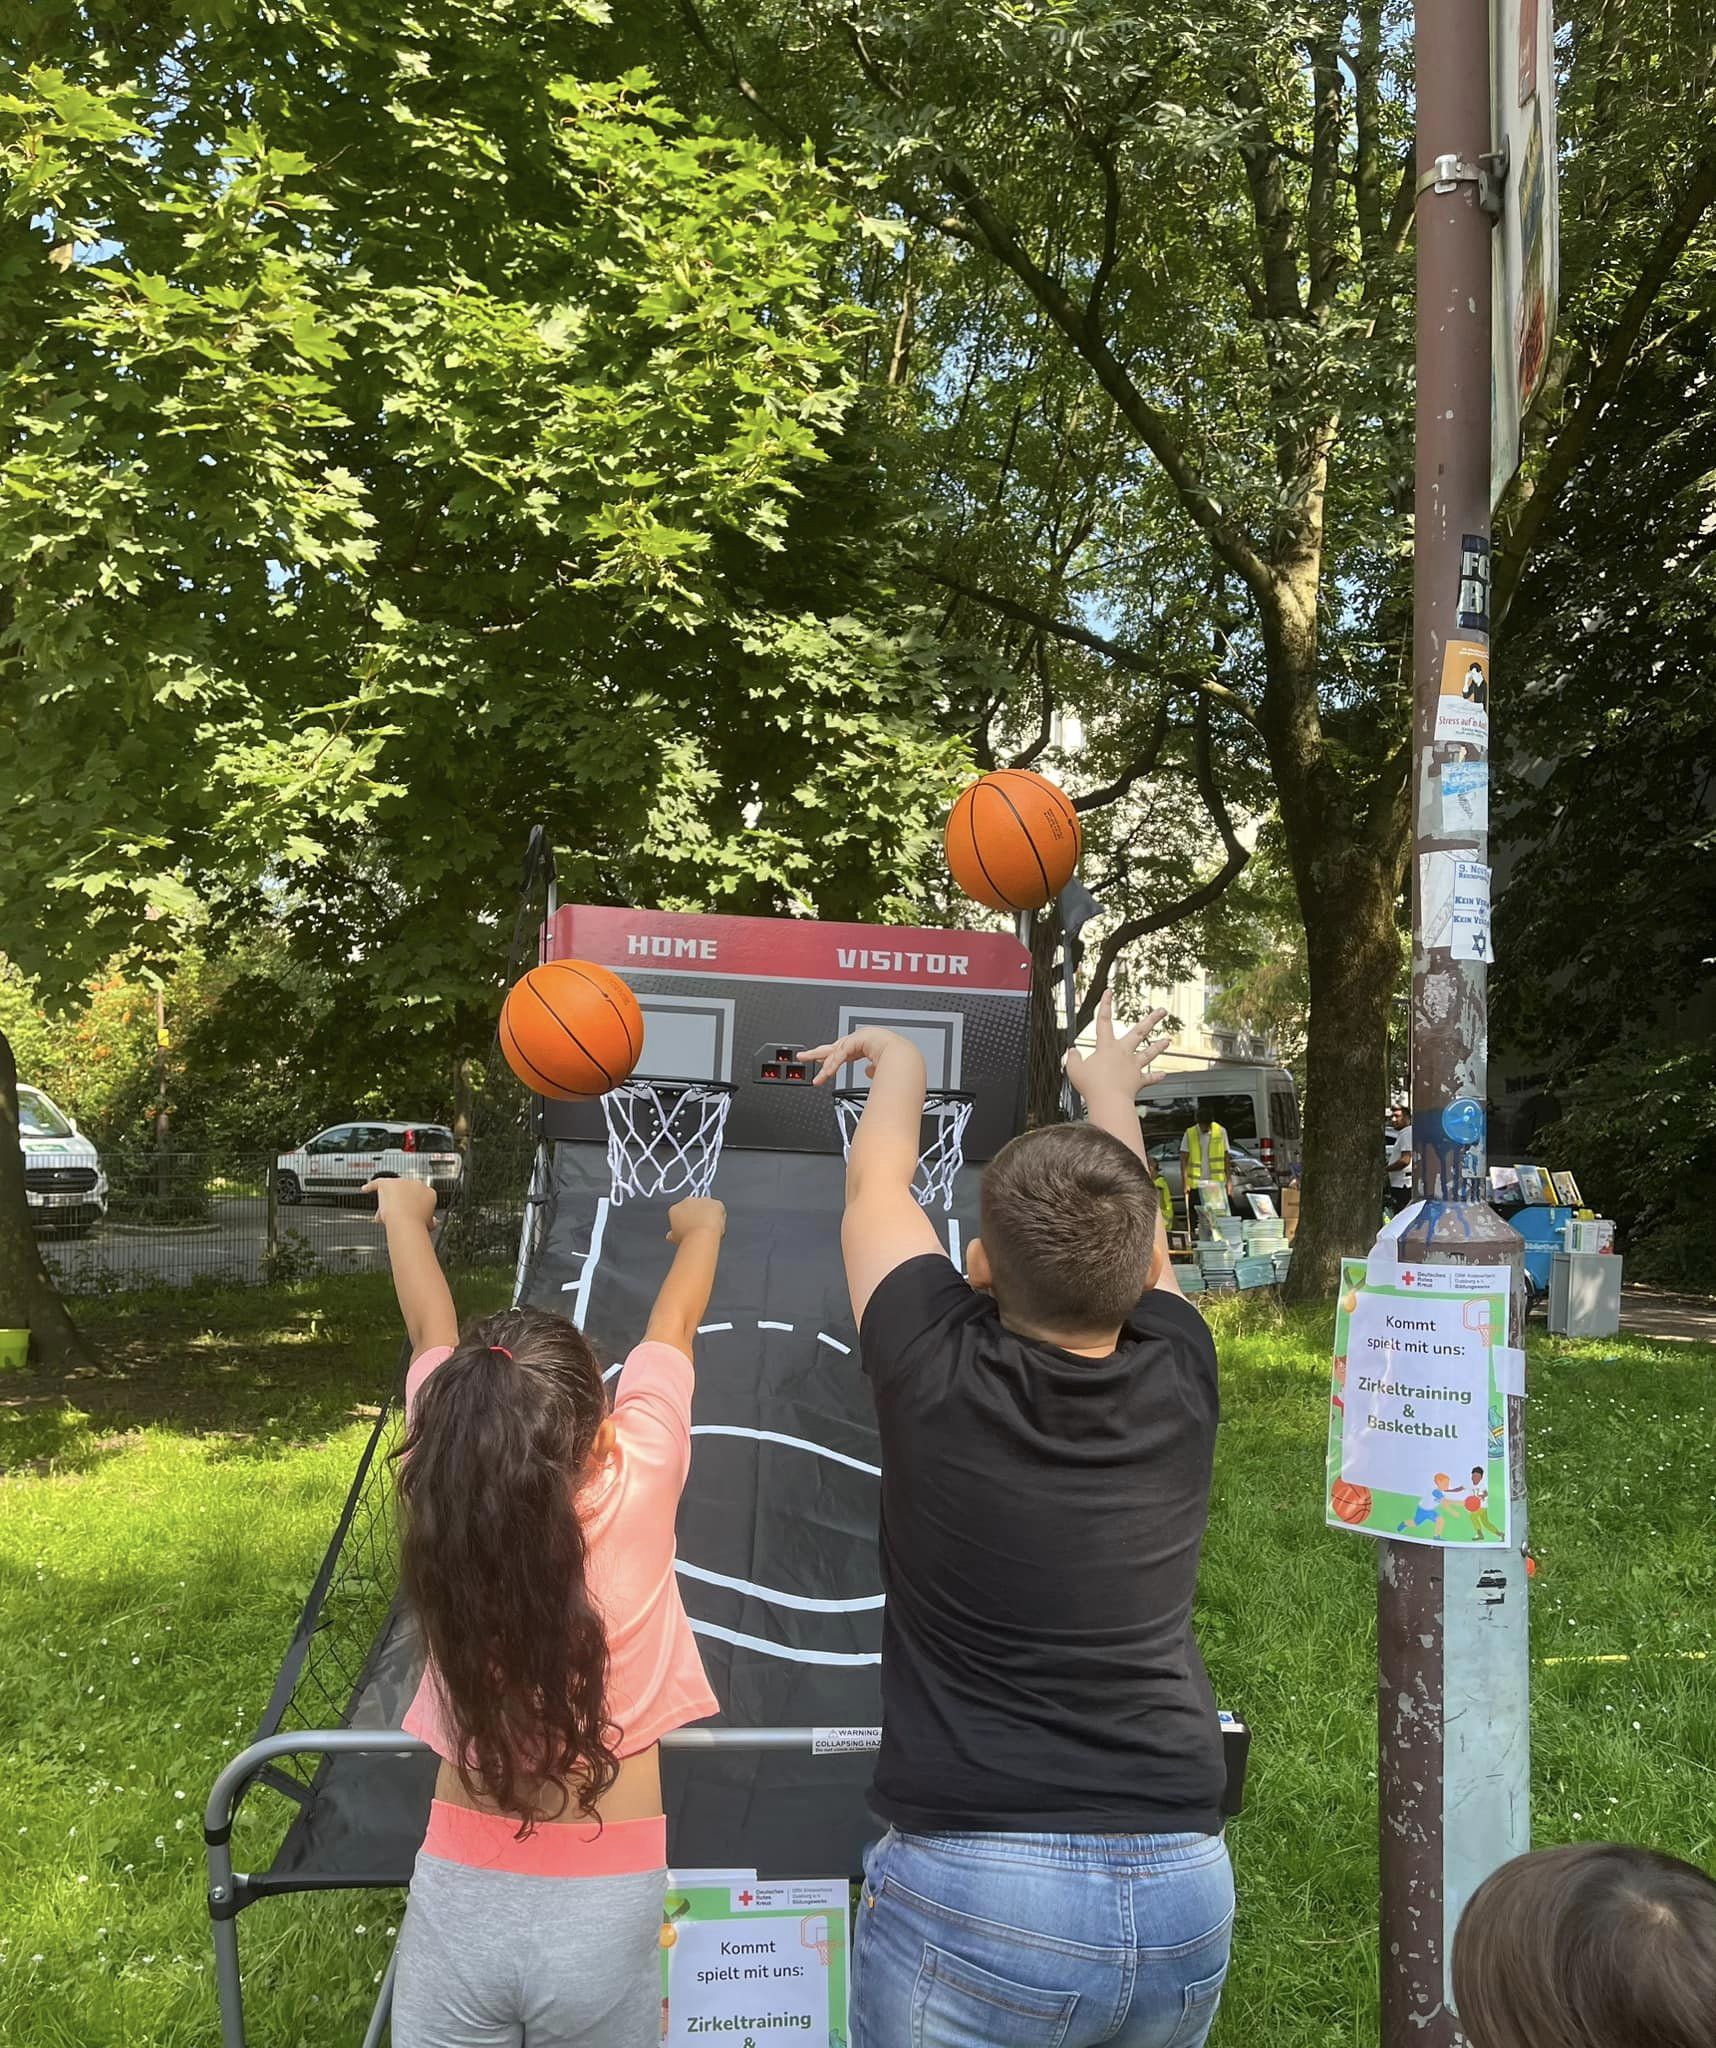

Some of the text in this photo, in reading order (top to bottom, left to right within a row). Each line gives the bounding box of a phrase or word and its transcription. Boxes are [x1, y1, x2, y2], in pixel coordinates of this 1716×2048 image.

[1439, 716, 1460, 726] Stress
[628, 935, 718, 960] HOME
[836, 948, 969, 976] VISITOR
[1385, 1315, 1436, 1332] Kommt
[1367, 1336, 1465, 1356] spielt mit uns:
[1358, 1376, 1472, 1405] Zirkeltraining
[1403, 1403, 1415, 1418] &
[1367, 1414, 1458, 1439] Basketball
[815, 1740, 864, 1748] COLLAPSING
[720, 1940, 776, 1956] Kommt
[697, 1964, 804, 1984] spielt mit uns:
[687, 2011, 811, 2033] Zirkeltraining
[743, 2036, 756, 2048] &
